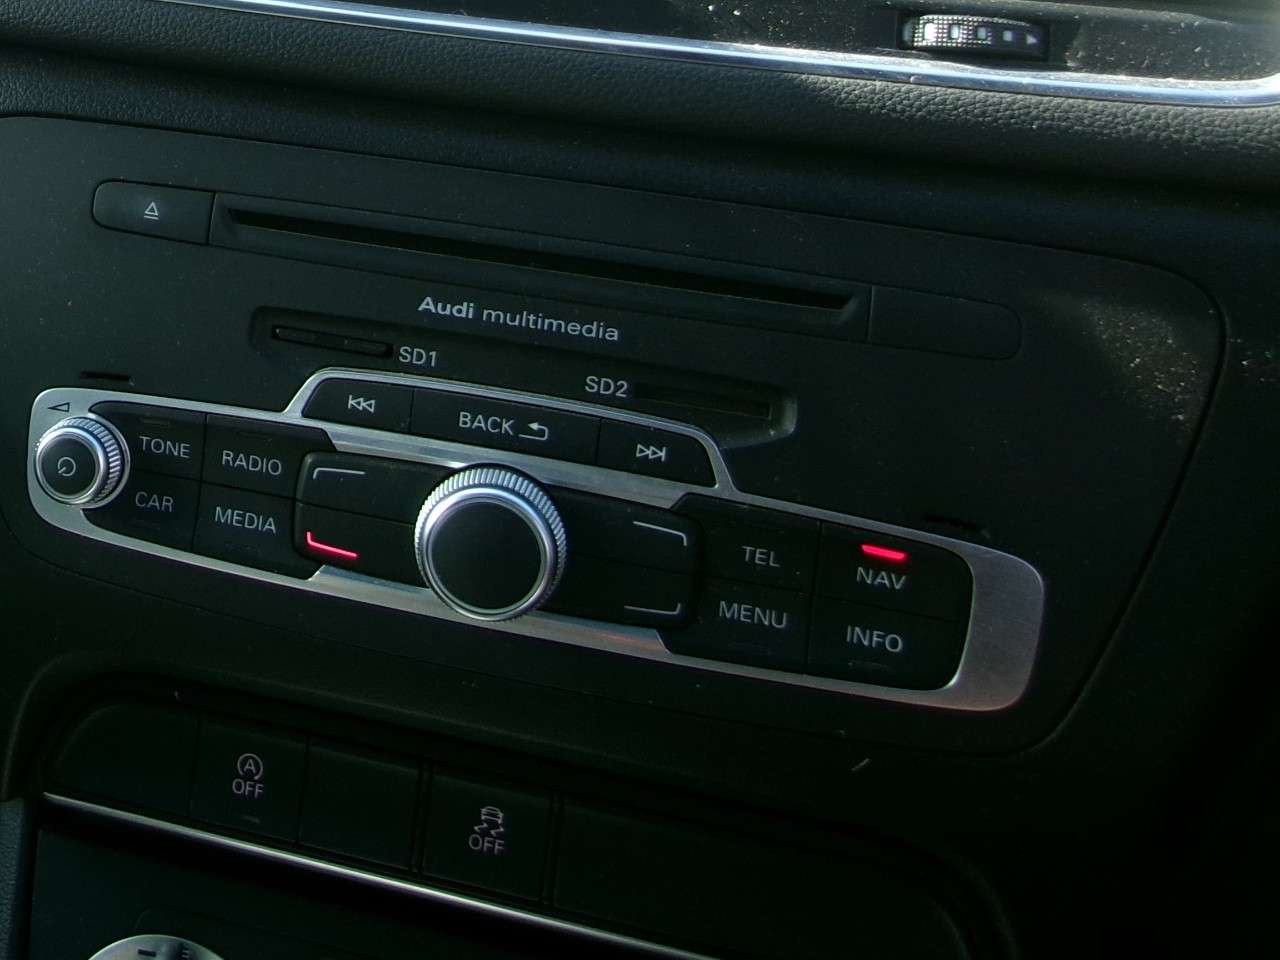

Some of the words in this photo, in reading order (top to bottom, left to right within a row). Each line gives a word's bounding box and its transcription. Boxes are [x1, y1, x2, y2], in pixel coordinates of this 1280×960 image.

[418, 296, 475, 319] Audi
[482, 307, 619, 341] multimedia
[398, 345, 438, 368] SD1
[584, 375, 629, 398] SD2
[458, 411, 515, 436] BACK
[139, 435, 192, 459] TONE
[221, 450, 283, 476] RADIO
[135, 491, 174, 513] CAR
[214, 506, 277, 535] MEDIA
[742, 545, 781, 568] TEL
[856, 566, 907, 591] NAV
[718, 600, 788, 630] MENU
[846, 624, 903, 654] INFO
[232, 778, 265, 799] OFF
[468, 833, 506, 855] OFF
